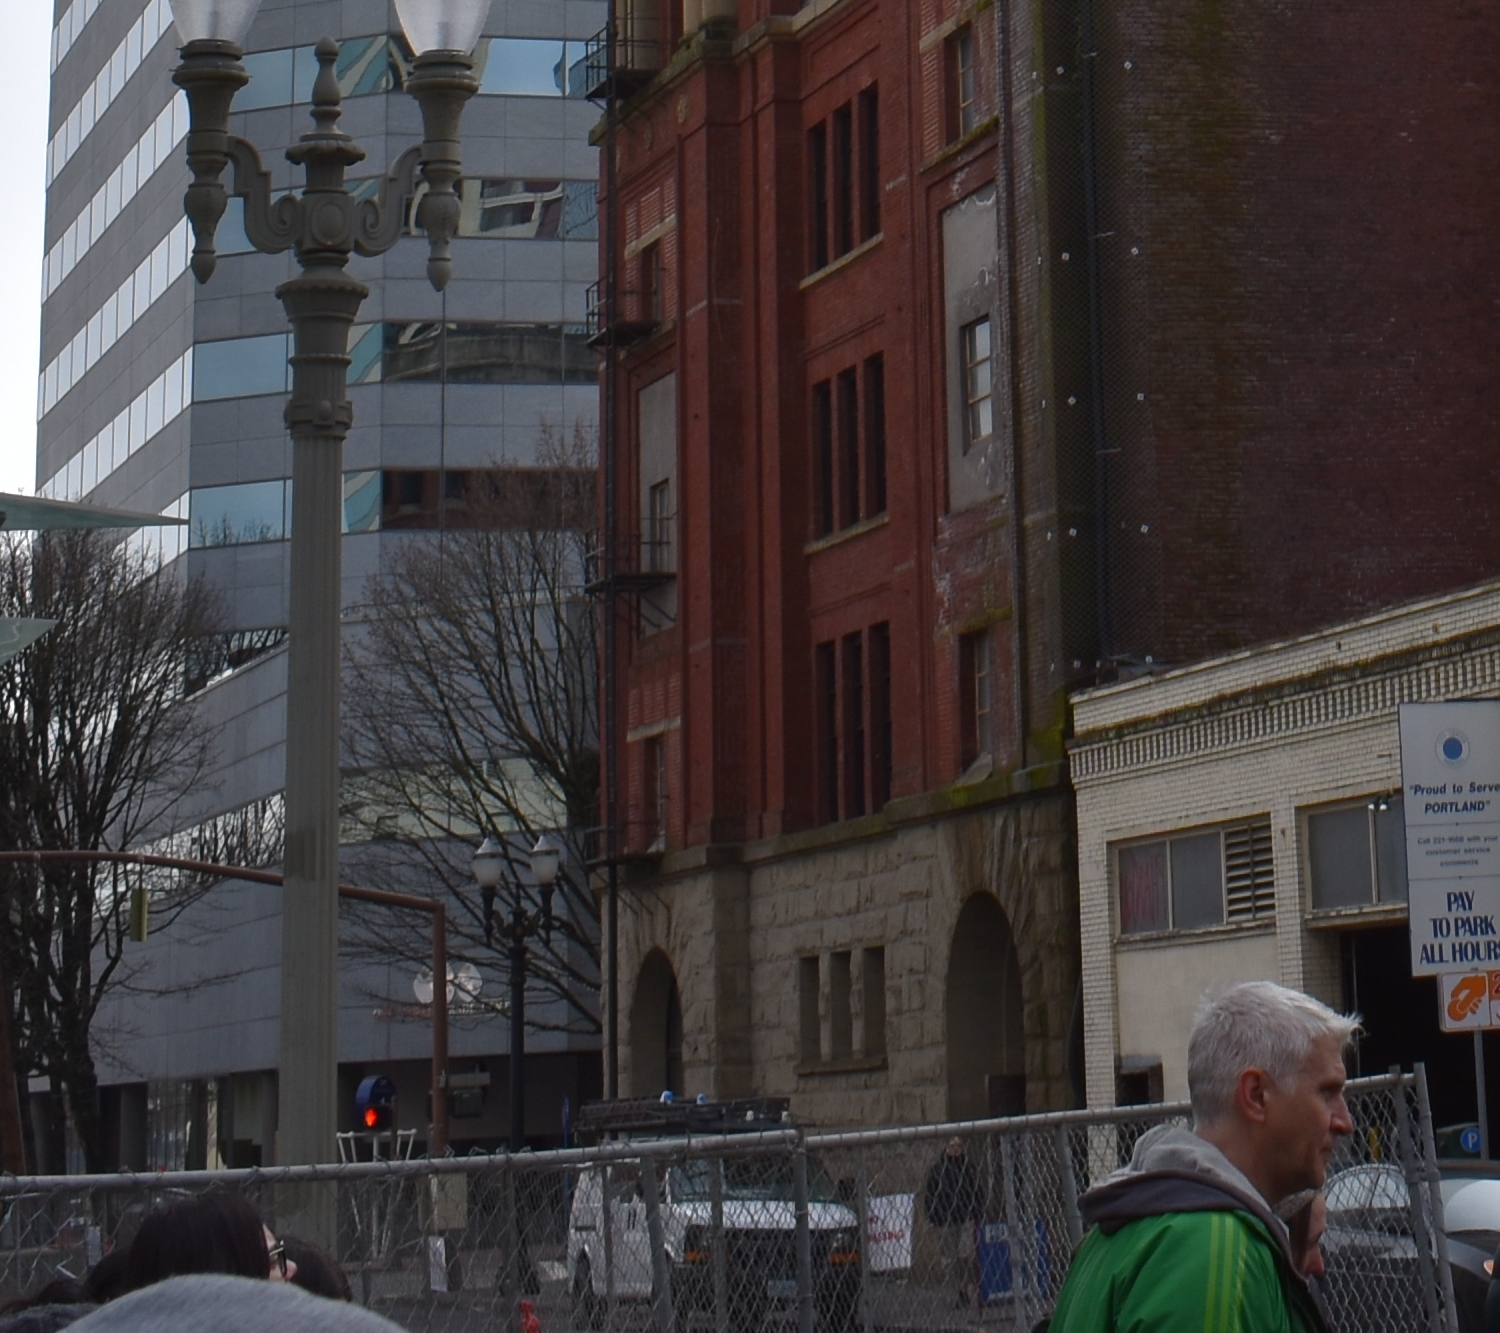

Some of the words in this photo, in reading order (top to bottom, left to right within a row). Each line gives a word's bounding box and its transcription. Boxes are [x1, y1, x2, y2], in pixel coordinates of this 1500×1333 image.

[1452, 783, 1463, 793] to
[1469, 782, 1500, 793] Serve
[1446, 890, 1475, 912] PAY
[1429, 917, 1451, 938] TO
[1454, 914, 1496, 937] PARK
[1420, 943, 1449, 965] ALL
